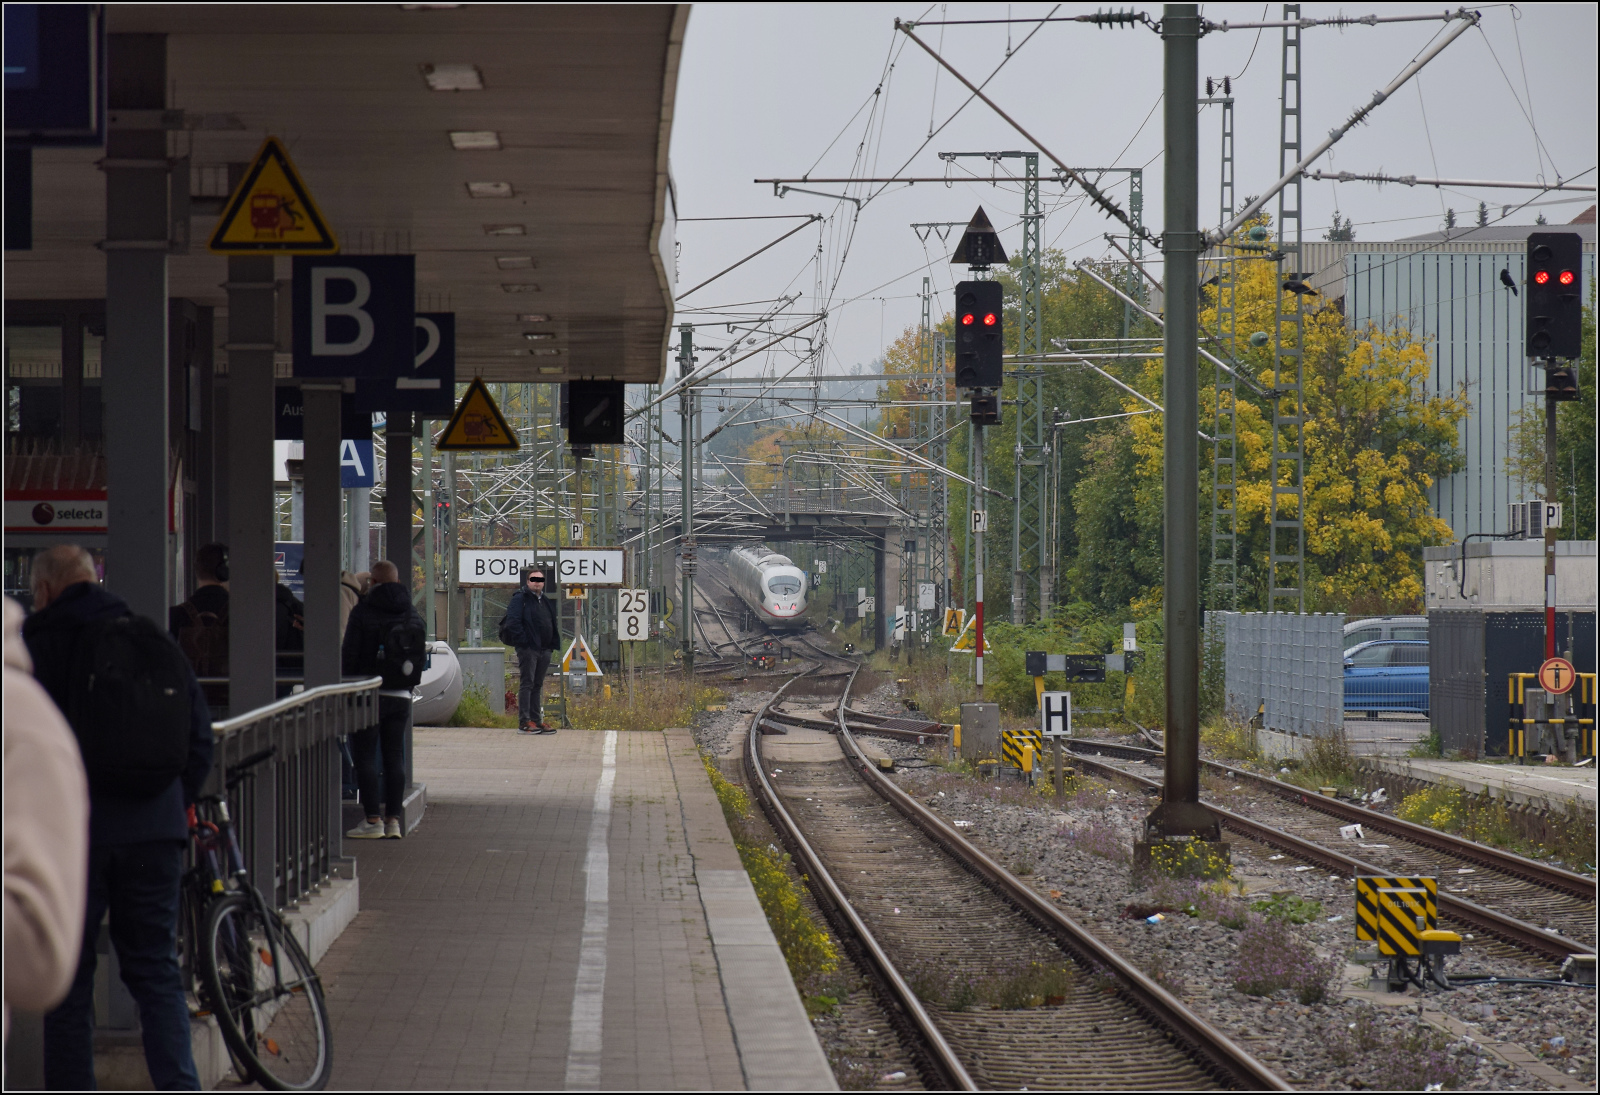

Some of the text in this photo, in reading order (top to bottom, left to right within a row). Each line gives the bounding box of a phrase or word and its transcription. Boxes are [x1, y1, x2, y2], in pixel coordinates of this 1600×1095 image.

[311, 266, 375, 357] B
[395, 316, 441, 389] 2
[340, 439, 366, 477] A
[57, 508, 102, 519] selecta
[973, 512, 986, 531] P2
[1546, 506, 1559, 526] P1
[475, 558, 607, 576] BÖBGEN
[921, 585, 935, 596] 25
[620, 592, 646, 613] 25
[627, 616, 639, 636] 8
[945, 612, 960, 634] A
[1045, 695, 1068, 731] H
